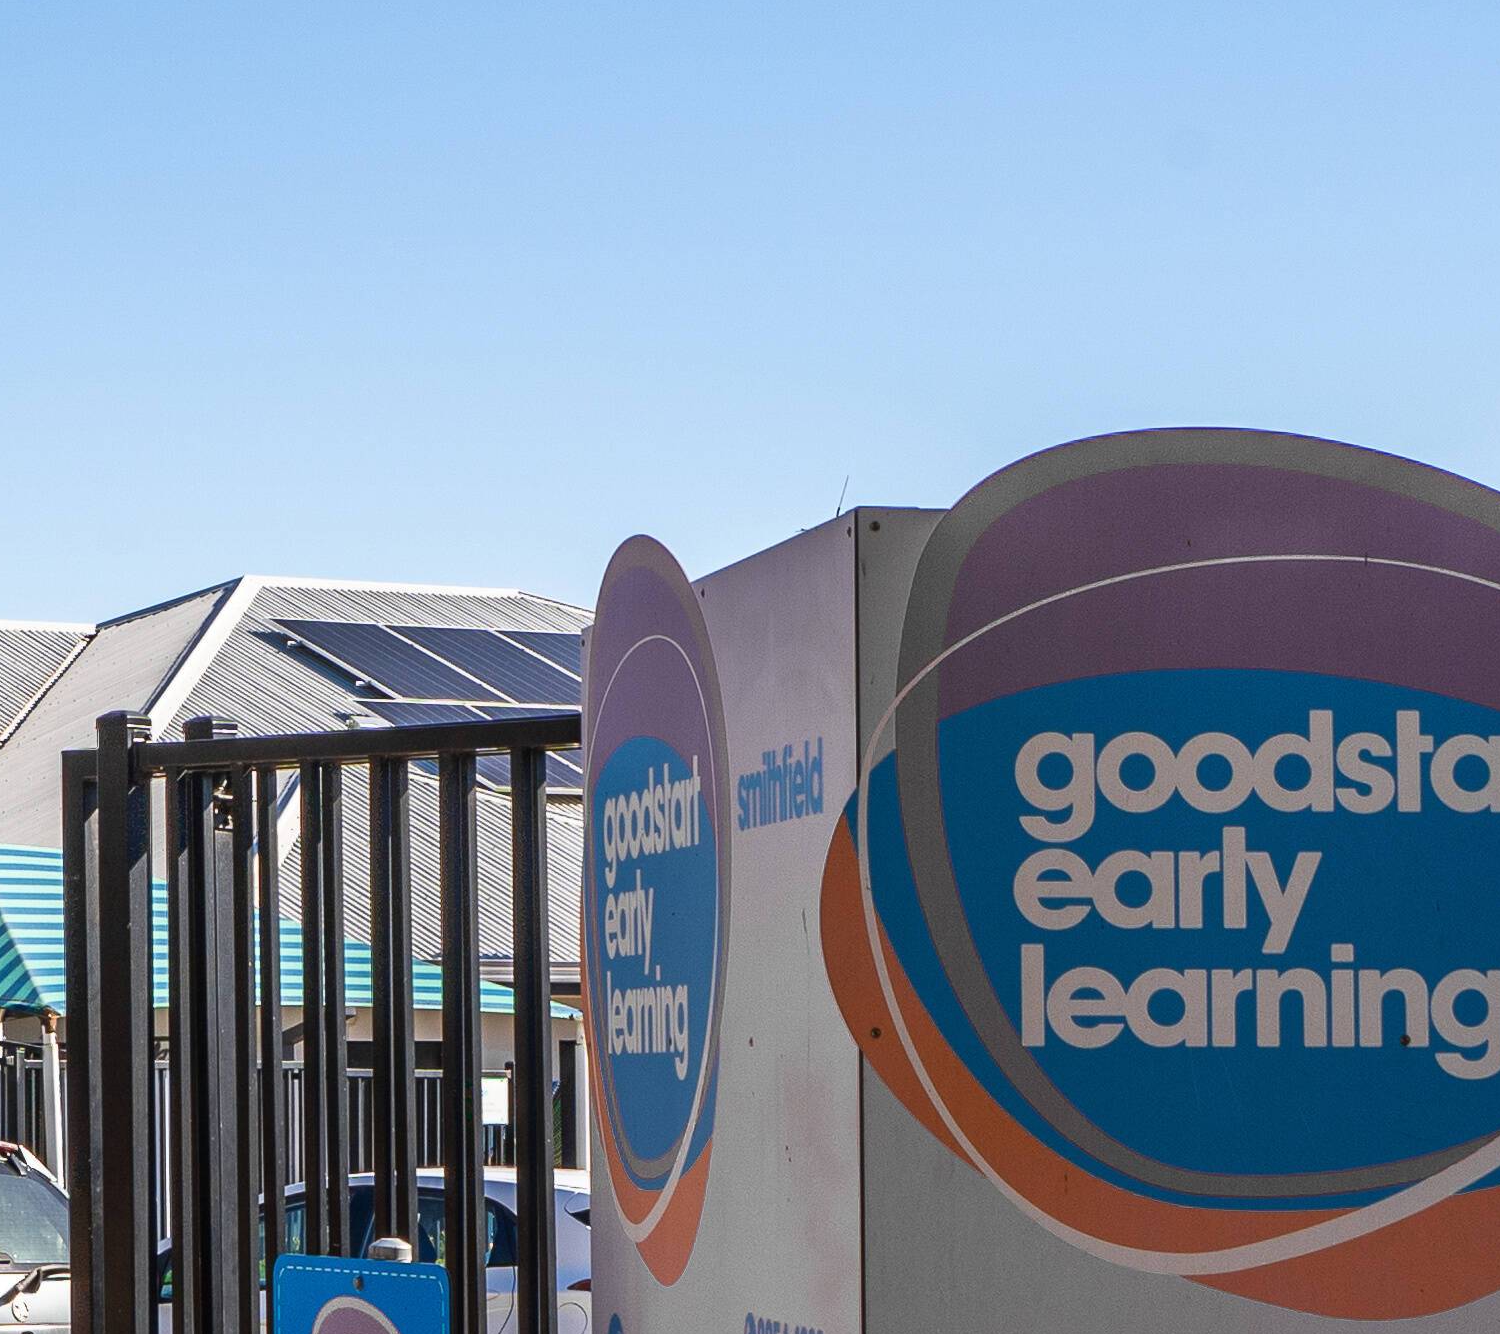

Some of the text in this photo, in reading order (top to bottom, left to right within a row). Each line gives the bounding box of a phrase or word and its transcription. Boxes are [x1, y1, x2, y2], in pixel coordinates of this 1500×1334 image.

[603, 754, 701, 888] goodstart
[737, 736, 823, 831] smithfield
[604, 868, 655, 975] early
[1013, 826, 1322, 954] early
[606, 965, 689, 1080] learning
